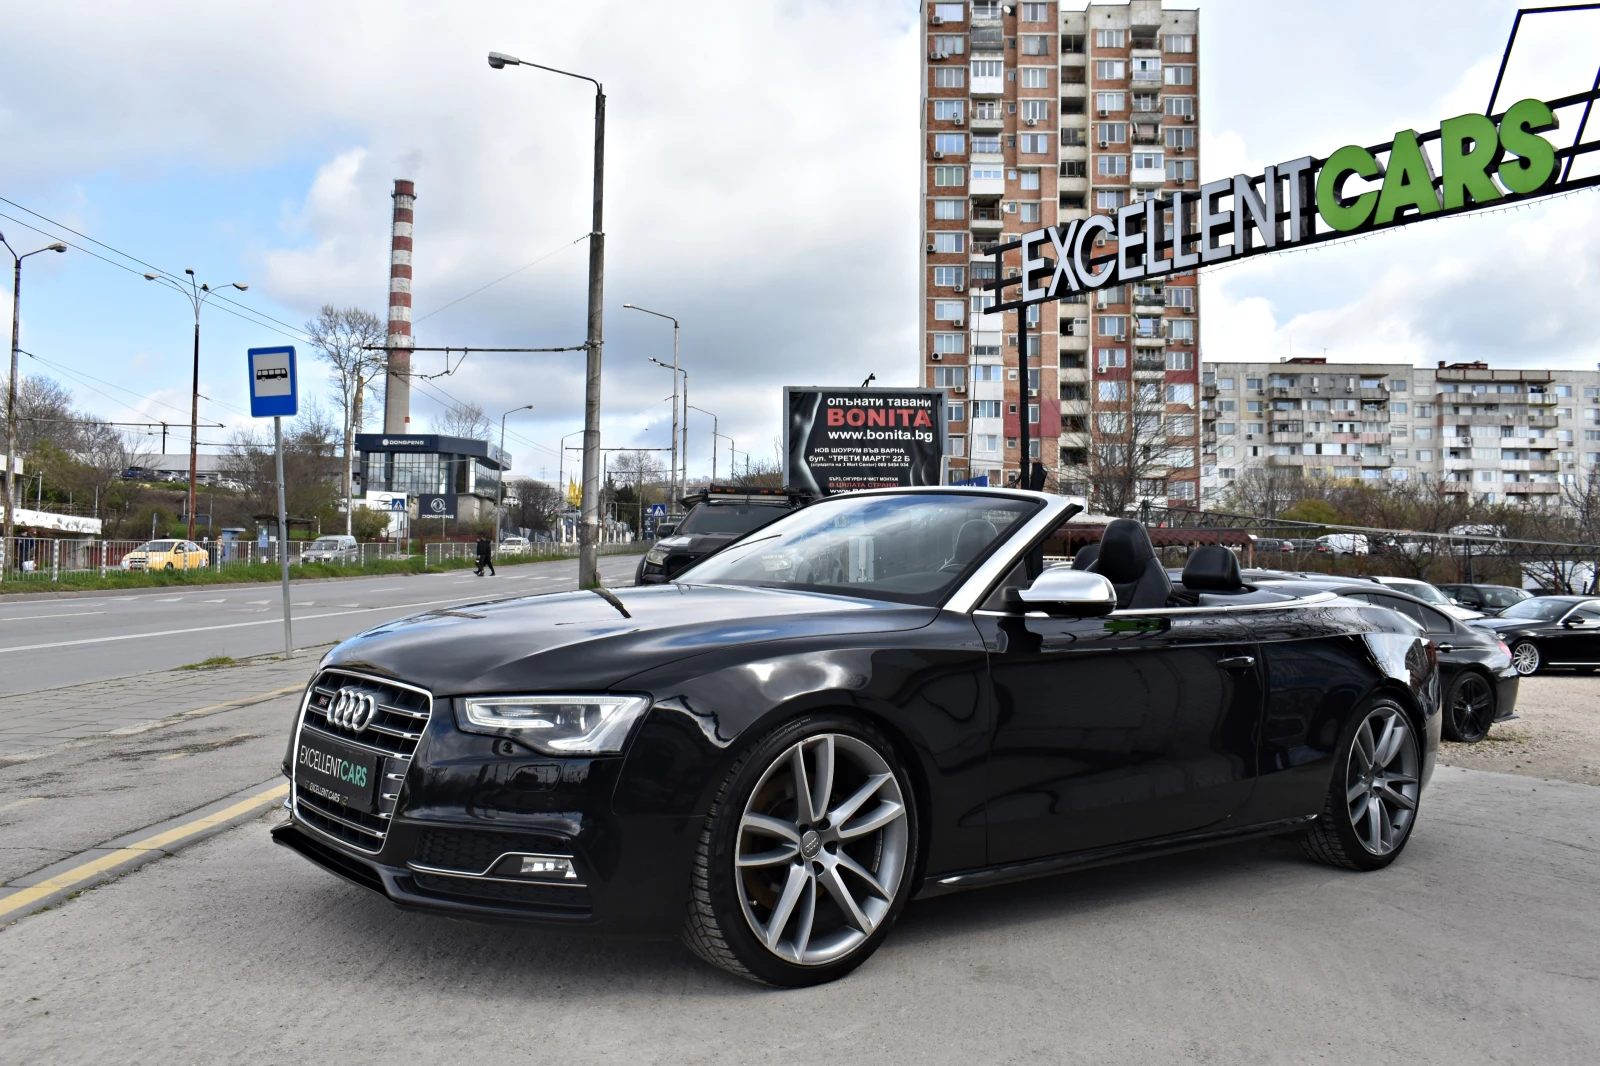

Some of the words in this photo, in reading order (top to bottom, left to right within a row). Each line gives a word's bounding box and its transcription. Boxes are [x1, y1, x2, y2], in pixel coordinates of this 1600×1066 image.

[827, 397, 884, 407] опънати
[887, 398, 932, 408] тавани
[827, 408, 932, 427] BONITA
[828, 430, 933, 442] www.bonita.bg
[328, 790, 340, 802] CARS
